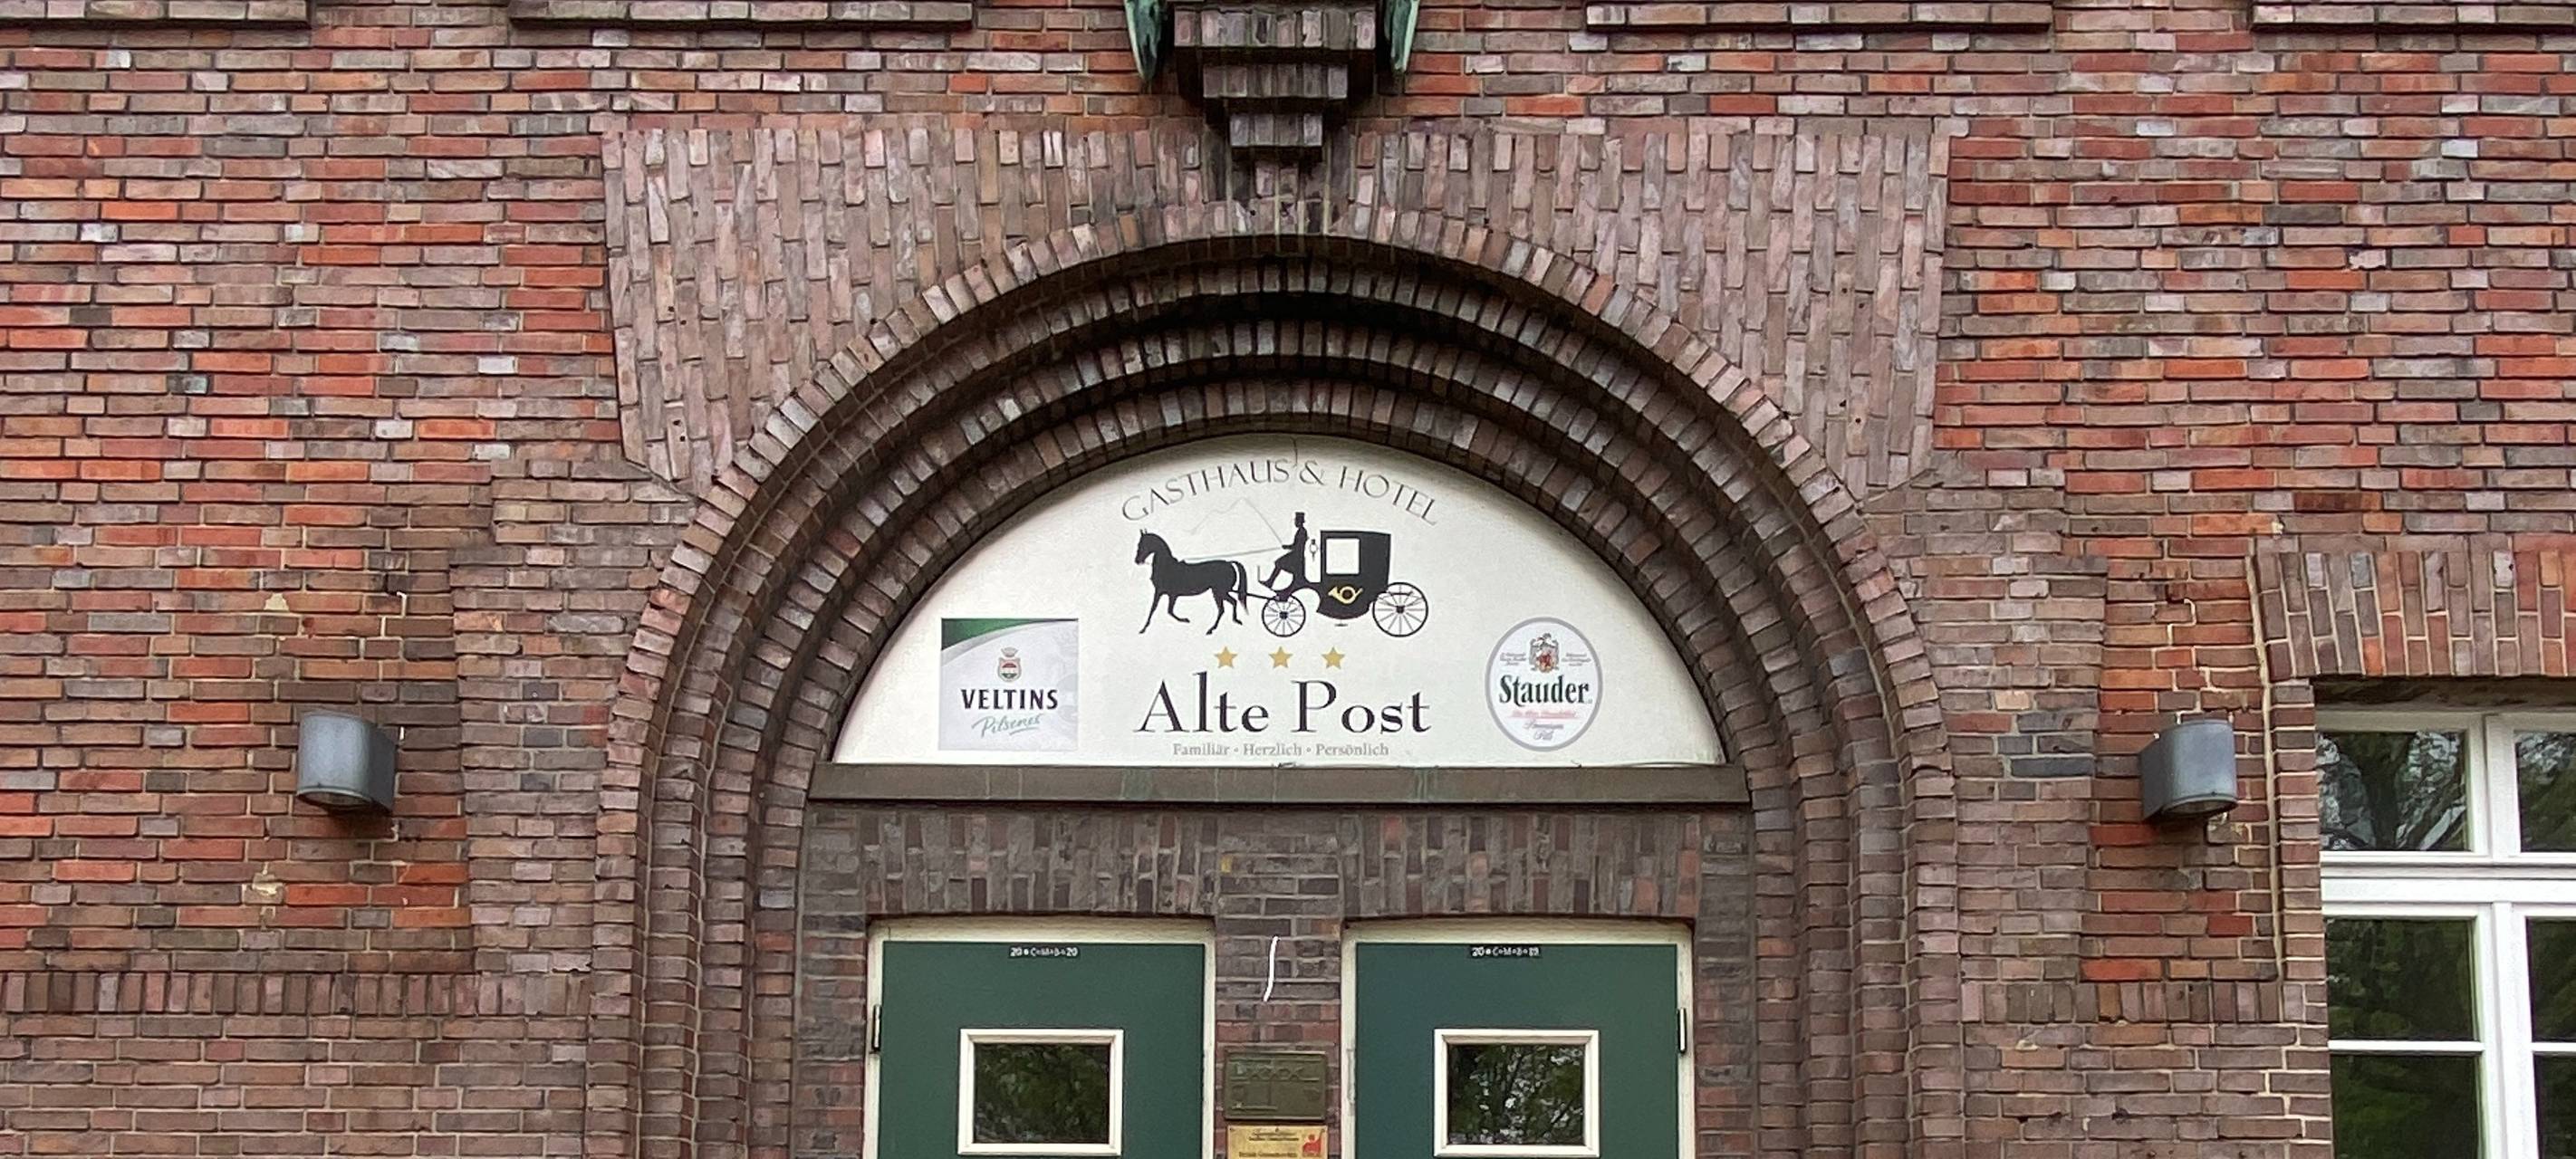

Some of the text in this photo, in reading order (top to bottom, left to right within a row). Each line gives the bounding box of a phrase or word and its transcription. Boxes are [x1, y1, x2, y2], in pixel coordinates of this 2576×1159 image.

[1121, 459, 1437, 525] GASTHAUS & HOTEL
[960, 688, 1059, 711] VELTINS
[1132, 670, 1432, 734] Alte Post
[1498, 675, 1590, 707] Stauder
[1172, 742, 1389, 756] Familiär Herzlich Persönlich
